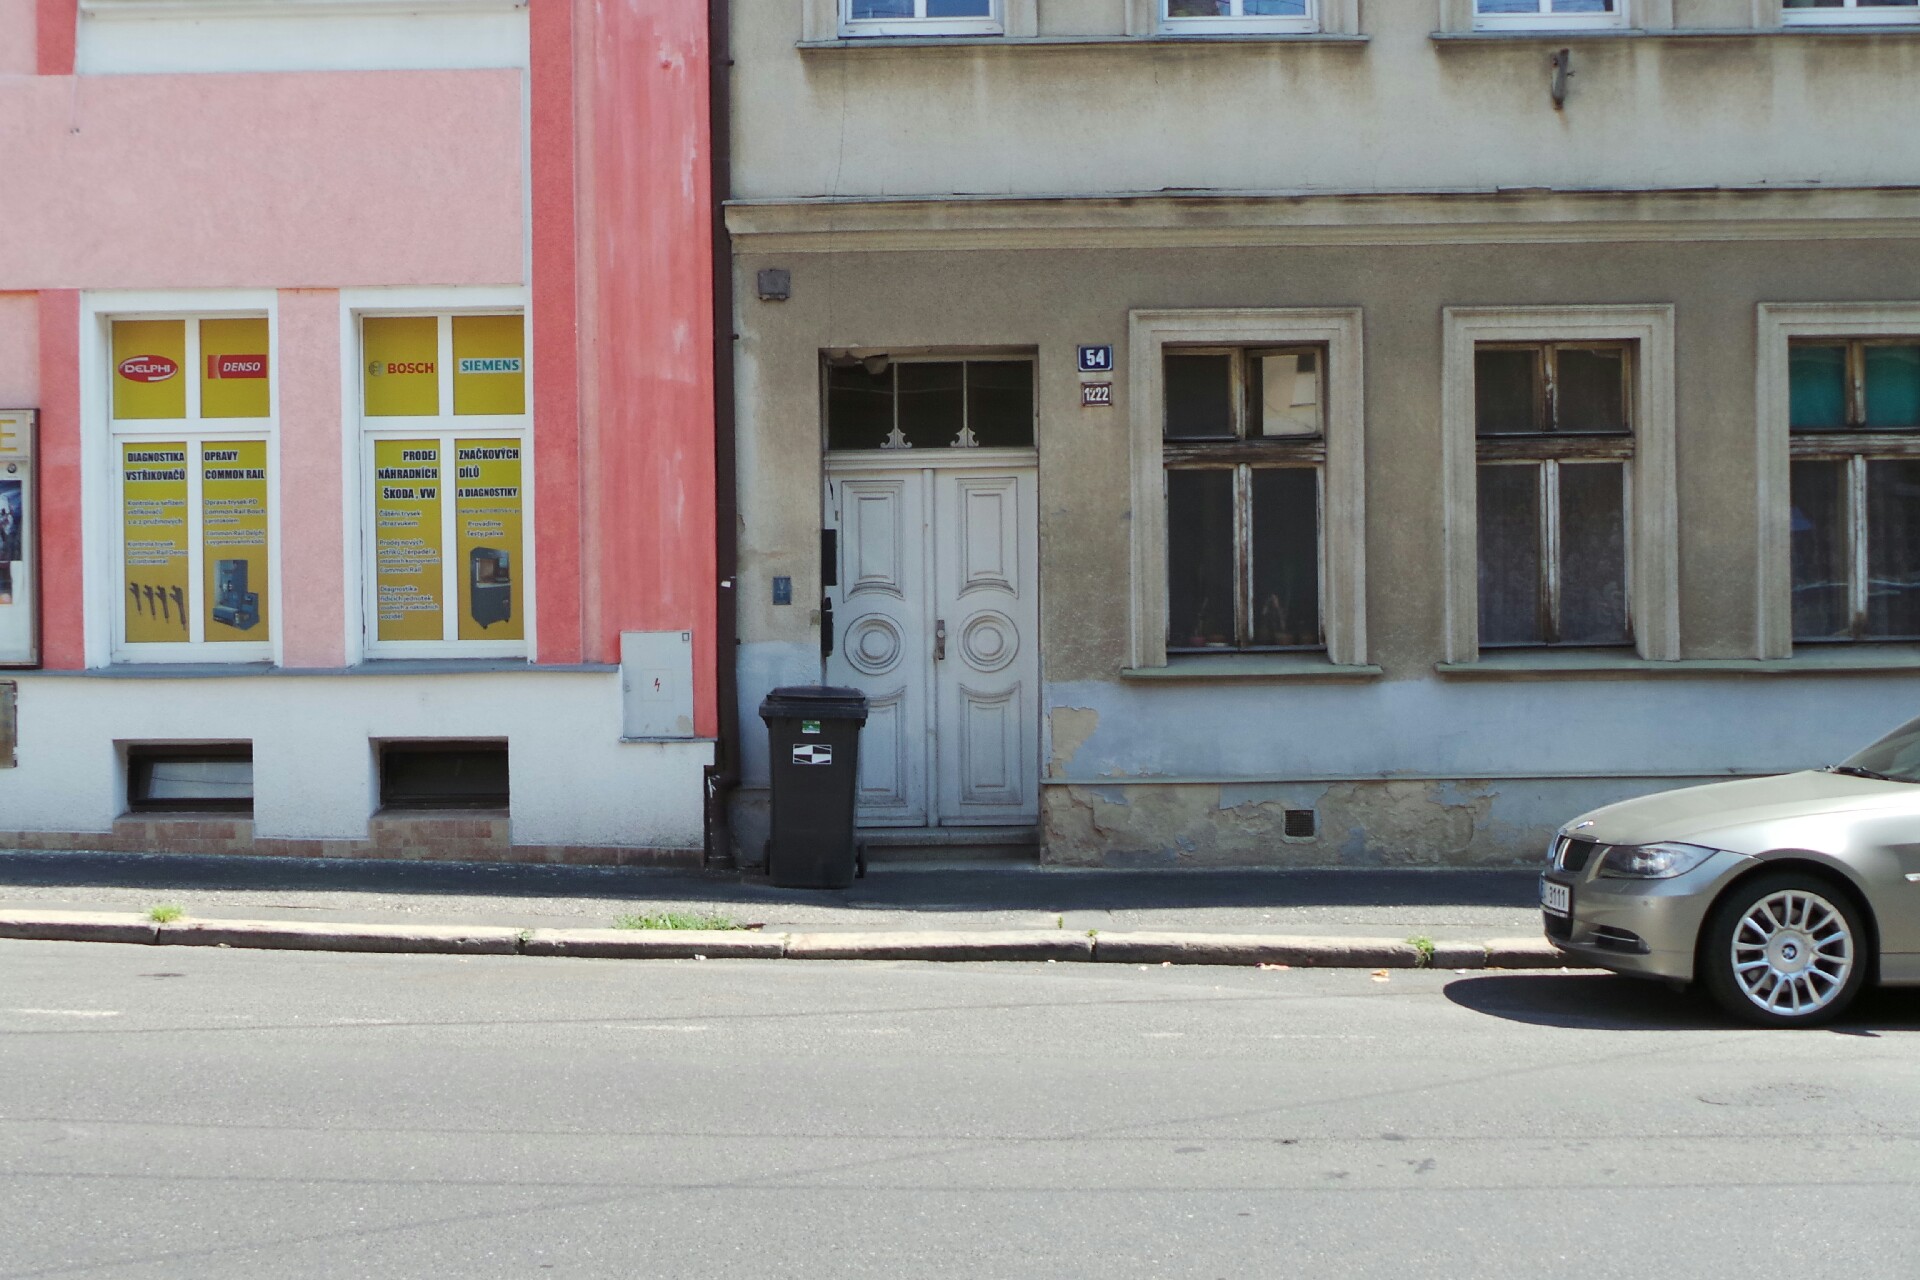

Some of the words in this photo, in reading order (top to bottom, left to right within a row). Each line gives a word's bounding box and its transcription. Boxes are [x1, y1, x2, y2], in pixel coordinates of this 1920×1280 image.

[1086, 349, 1105, 366] 54
[124, 364, 171, 373] DELPHI
[223, 362, 261, 372] DENSO
[387, 362, 434, 374] BOSCH
[461, 359, 519, 371] SIEMENS
[1084, 387, 1109, 401] 1222
[127, 452, 185, 462] DIAGNOSTIKA
[204, 451, 238, 461] OPRAVY
[402, 450, 437, 461] PRODEJ
[458, 447, 519, 460] ZNAČKOVÝCH
[205, 469, 244, 480] COMMON
[246, 469, 265, 479] RAIL
[378, 467, 438, 479] NÁHRADNÍCH
[459, 465, 480, 478] DÍLŮ
[419, 487, 436, 499] VW
[458, 488, 464, 498] A
[464, 487, 518, 498] DIAGNOSTIKY
